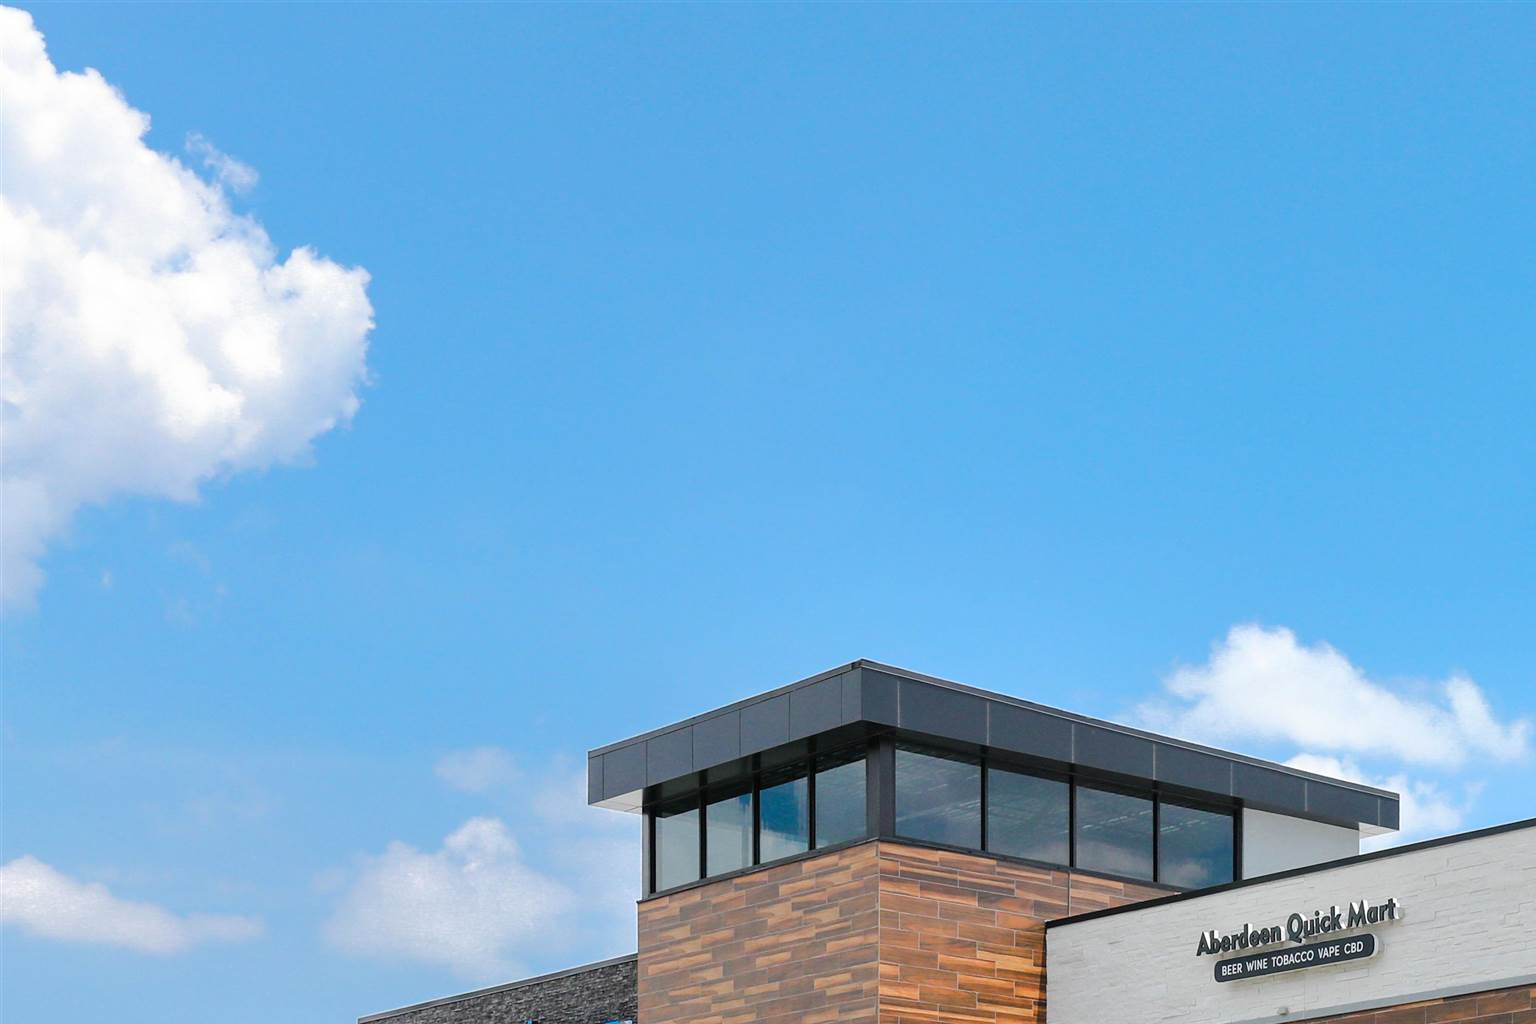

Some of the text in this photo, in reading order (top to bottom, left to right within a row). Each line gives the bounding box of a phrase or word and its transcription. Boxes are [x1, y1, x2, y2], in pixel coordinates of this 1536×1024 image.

[1197, 898, 1397, 956] Aberdeen Quick Mart
[1221, 941, 1364, 977] BEER WINE TOBACCO VAPE CBD
